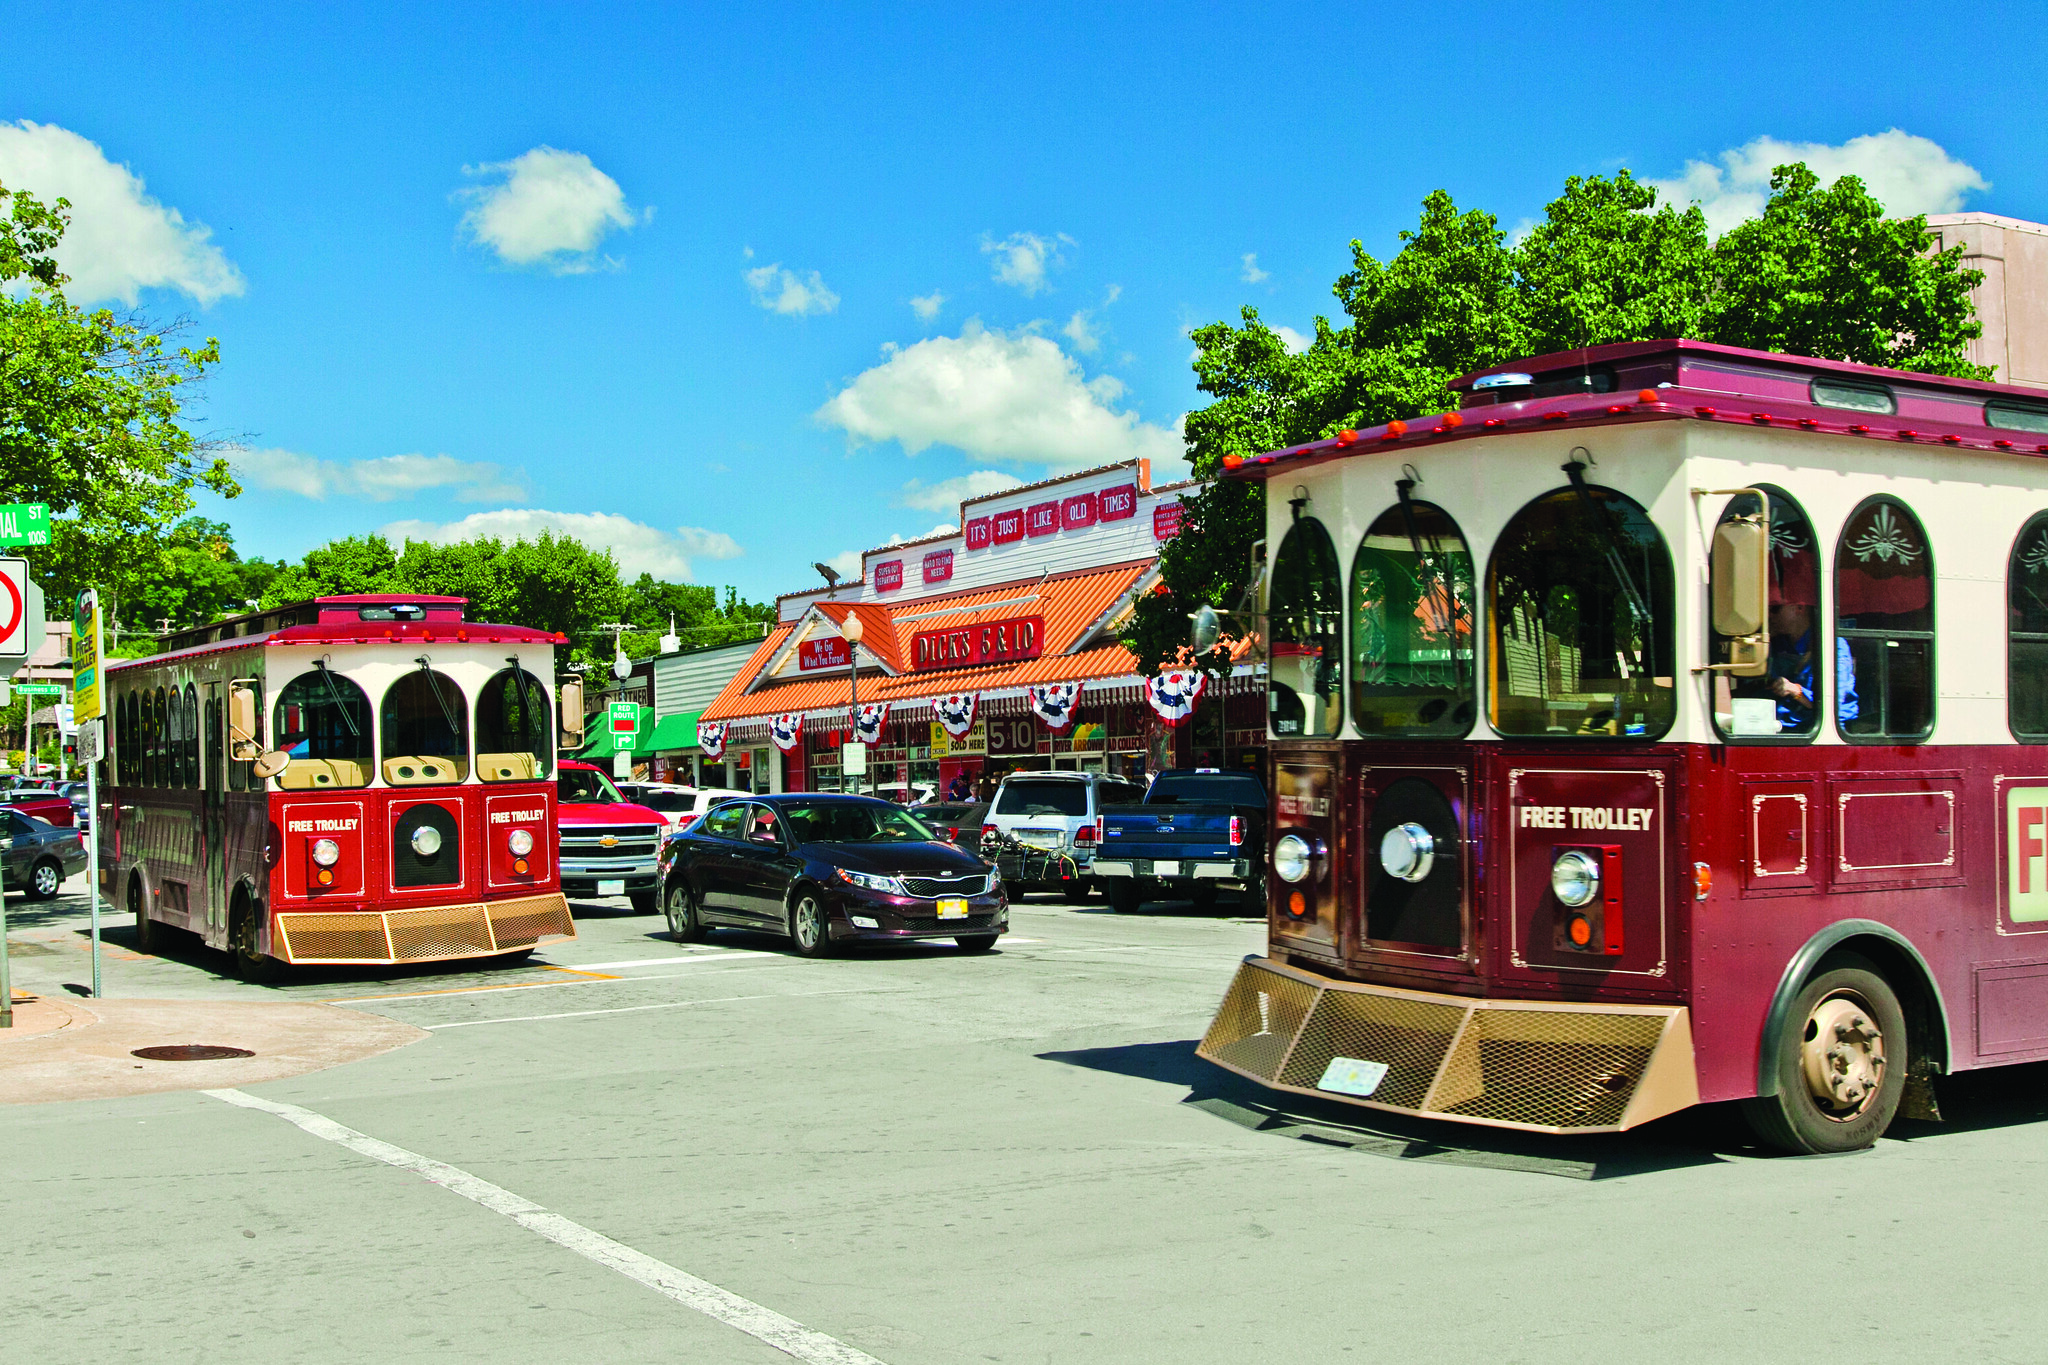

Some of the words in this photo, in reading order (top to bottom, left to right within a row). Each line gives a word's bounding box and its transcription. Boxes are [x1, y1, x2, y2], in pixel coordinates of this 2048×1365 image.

[29, 505, 43, 519] ST
[970, 525, 986, 542] IT'S
[997, 518, 1018, 536] JUST
[1033, 510, 1052, 528] LIKE
[1069, 502, 1087, 521] OLD
[1103, 493, 1130, 514] TIMES
[27, 530, 47, 545] 100S
[814, 641, 823, 653] We
[824, 639, 833, 652] Got
[919, 631, 970, 662] DICK'S
[982, 627, 991, 654] 5
[1014, 622, 1034, 651] 10
[803, 655, 818, 668] What
[818, 653, 828, 666] You
[828, 651, 845, 664] Forgot
[950, 740, 967, 751] SOLD
[969, 739, 985, 750] HERE
[490, 811, 510, 824] FREE
[511, 809, 544, 822] TROLLEY
[1521, 806, 1566, 828] FREE
[1569, 807, 1653, 831] TROLLEY
[288, 820, 313, 832] FREE
[315, 818, 358, 831] TROLLEY
